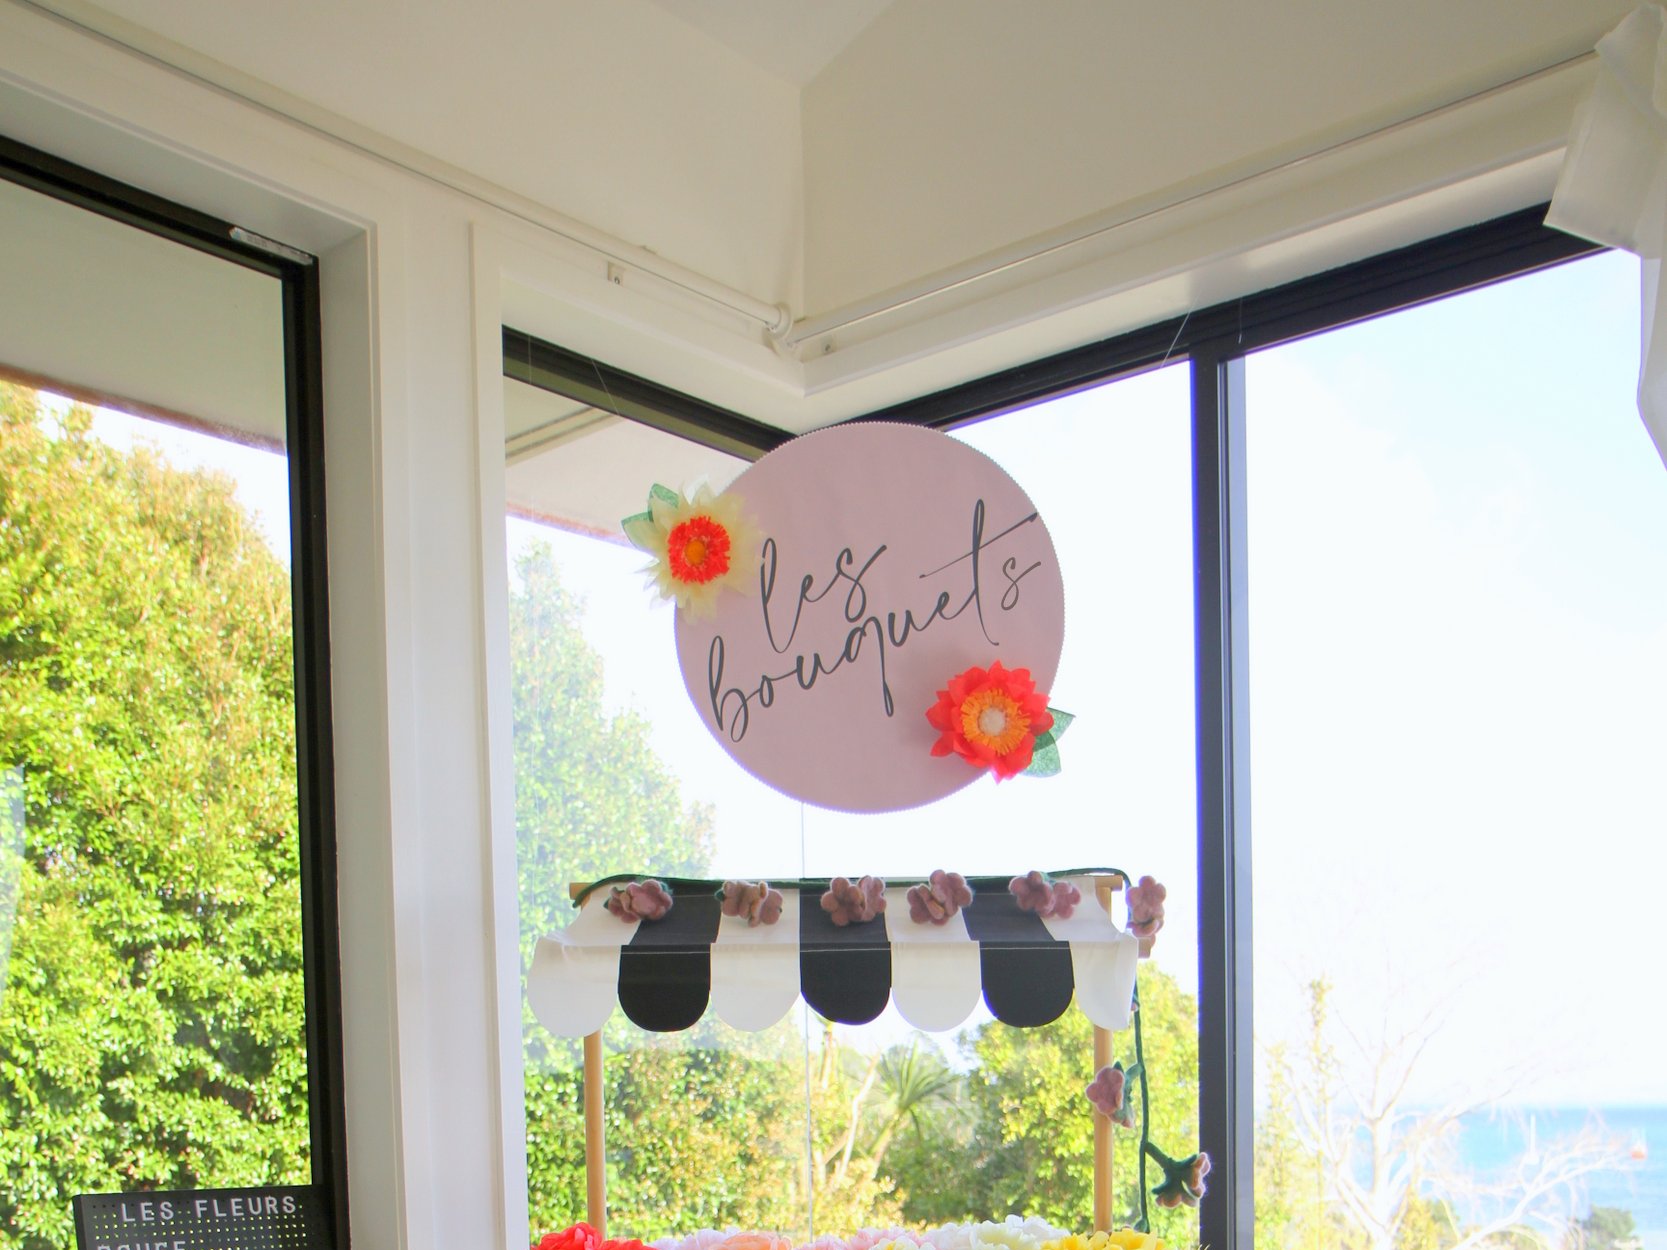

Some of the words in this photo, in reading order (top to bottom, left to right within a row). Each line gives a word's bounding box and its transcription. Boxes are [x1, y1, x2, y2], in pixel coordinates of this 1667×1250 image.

[708, 498, 1042, 743] bouquets
[760, 537, 887, 654] les
[120, 1201, 175, 1223] LES
[195, 1195, 297, 1219] FLEURS
